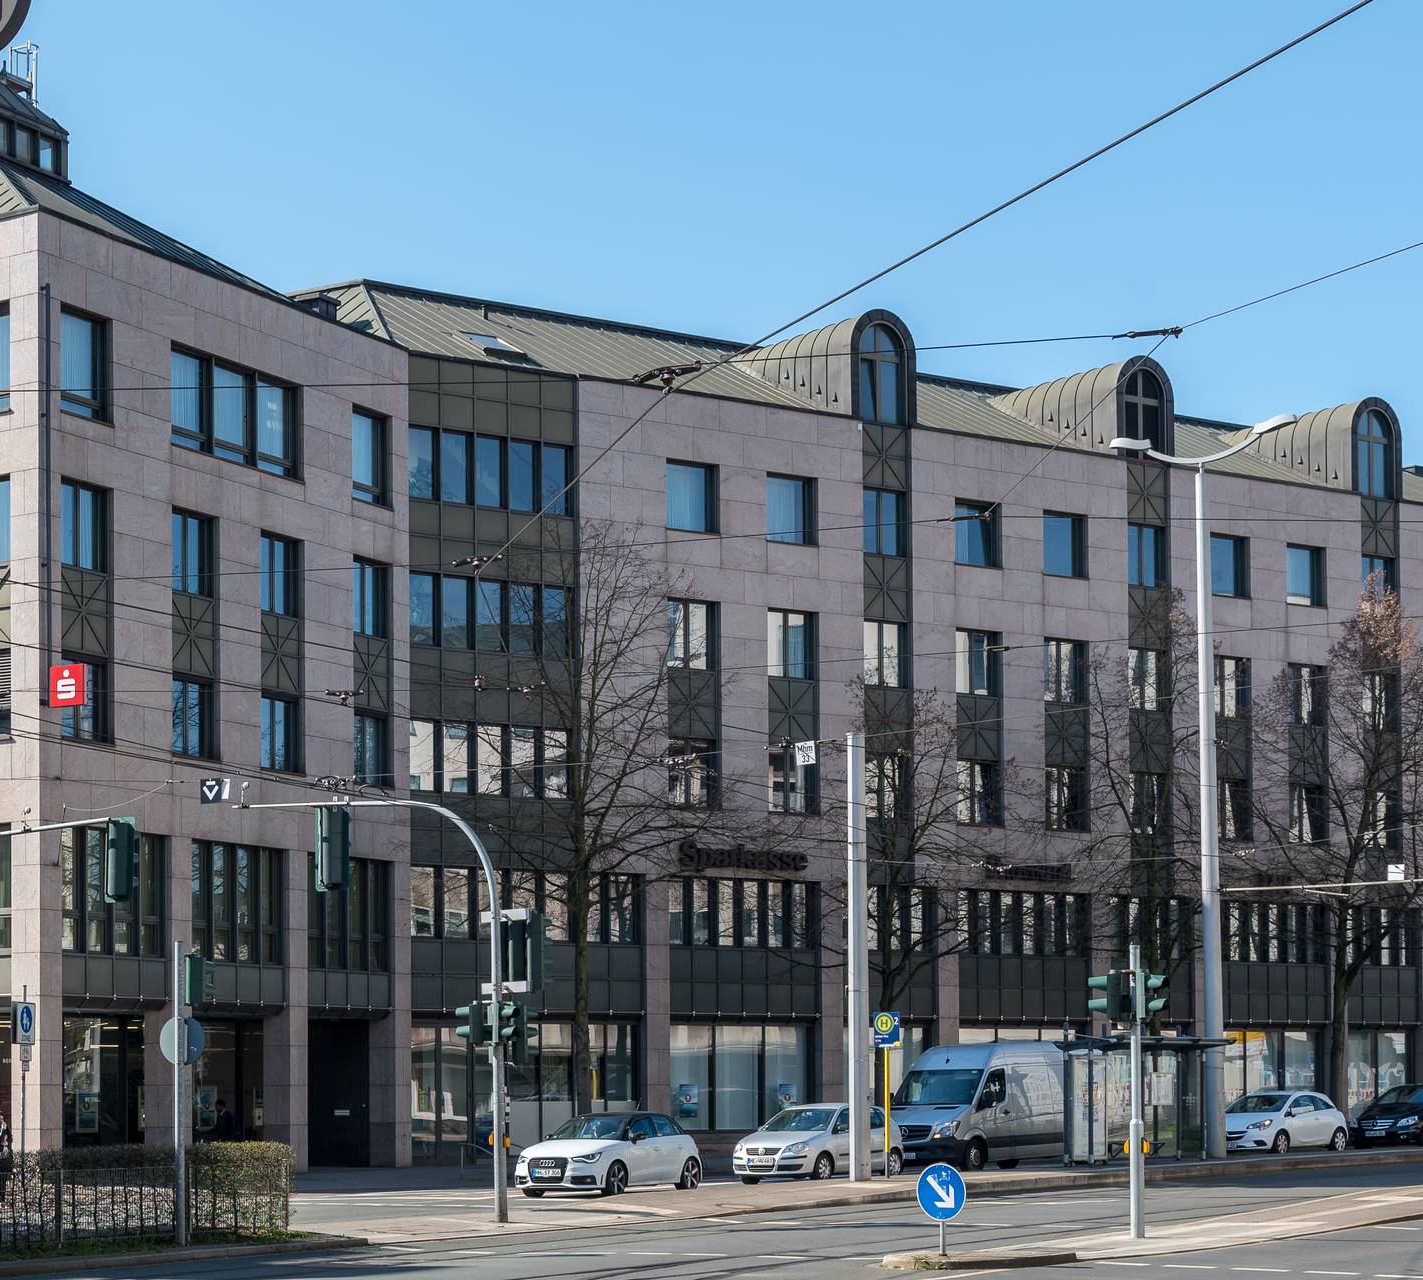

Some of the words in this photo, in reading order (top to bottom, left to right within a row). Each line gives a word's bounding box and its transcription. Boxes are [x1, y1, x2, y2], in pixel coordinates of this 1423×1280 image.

[797, 743, 813, 753] Mhm
[802, 754, 810, 763] 33
[678, 839, 809, 871] Sparkasse
